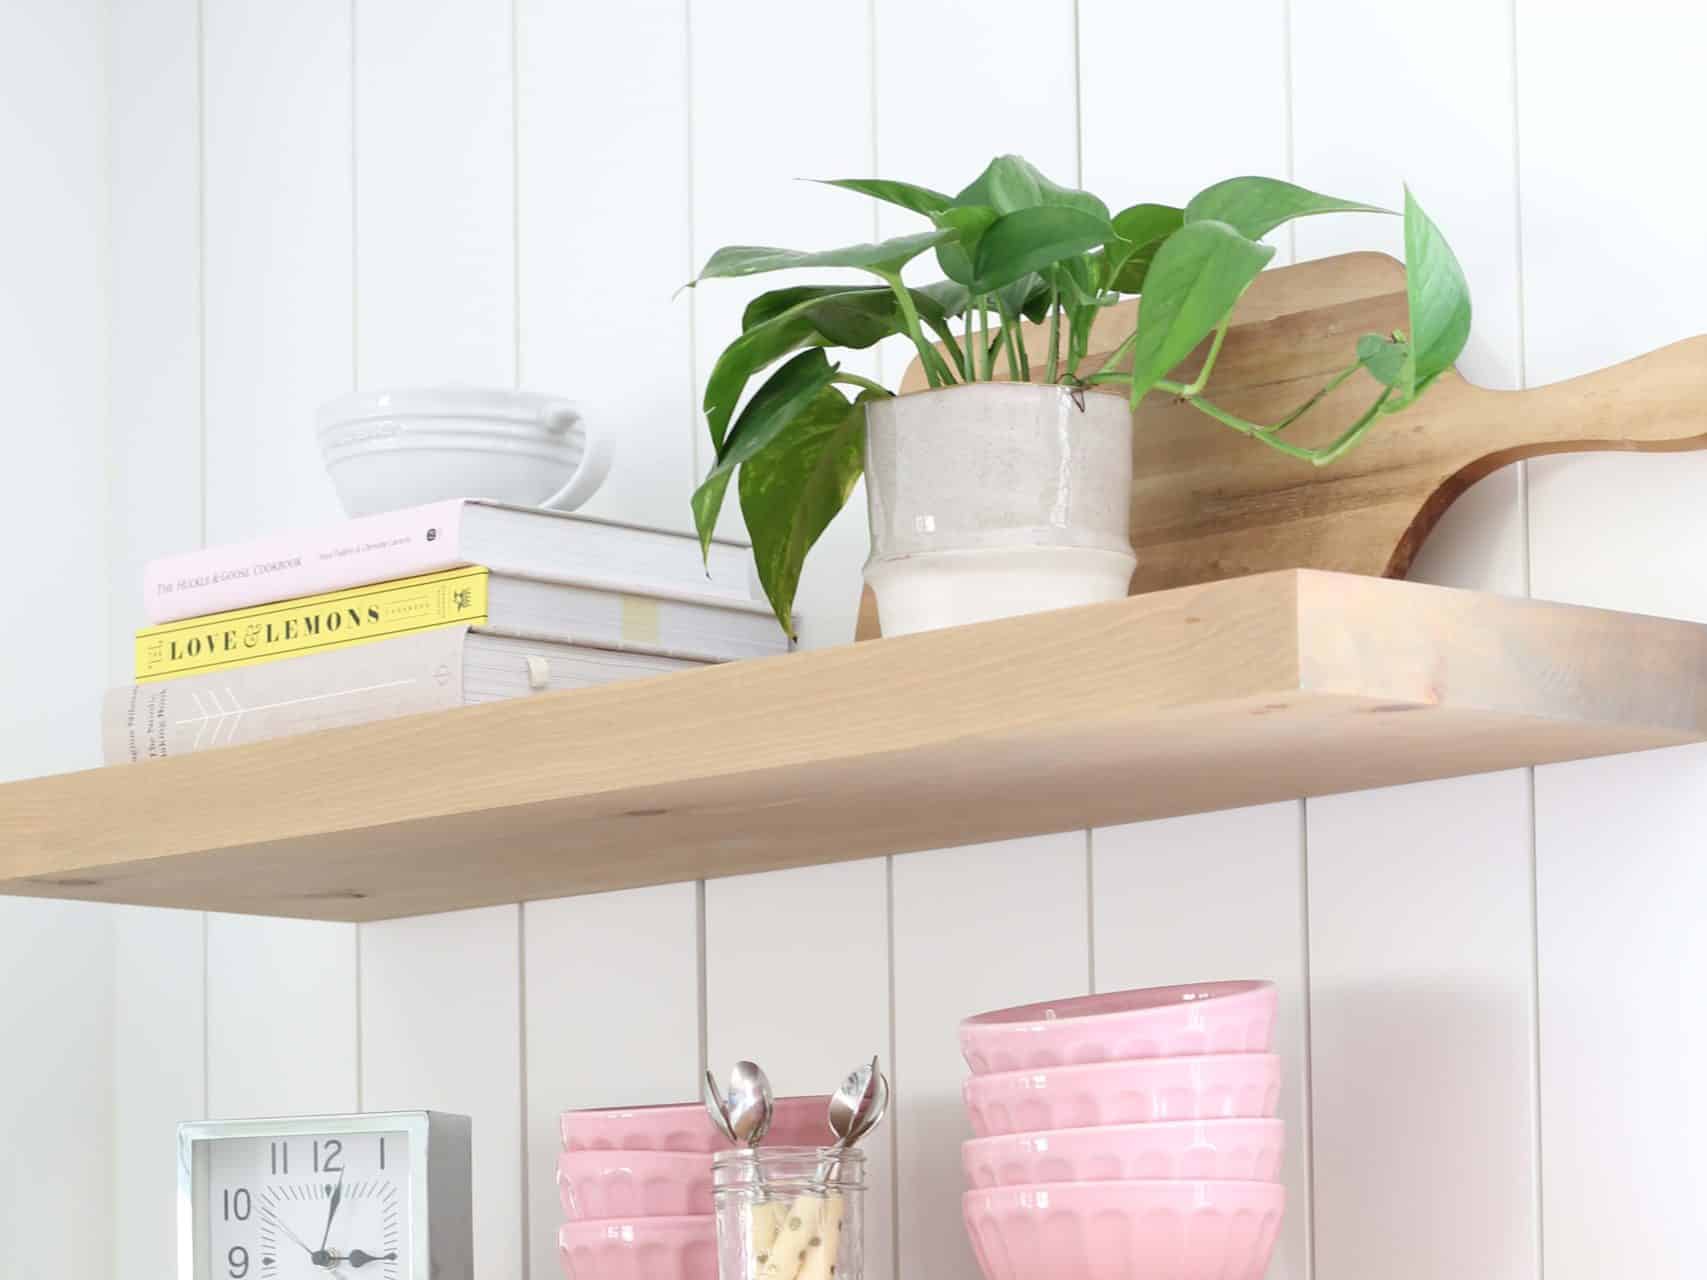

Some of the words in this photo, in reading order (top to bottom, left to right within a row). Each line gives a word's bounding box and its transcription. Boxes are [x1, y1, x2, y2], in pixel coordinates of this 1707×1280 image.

[271, 1140, 289, 1175] 11
[312, 1139, 343, 1173] 12
[379, 1136, 386, 1171] 1
[223, 1187, 252, 1222] 10
[228, 1245, 250, 1280] 9
